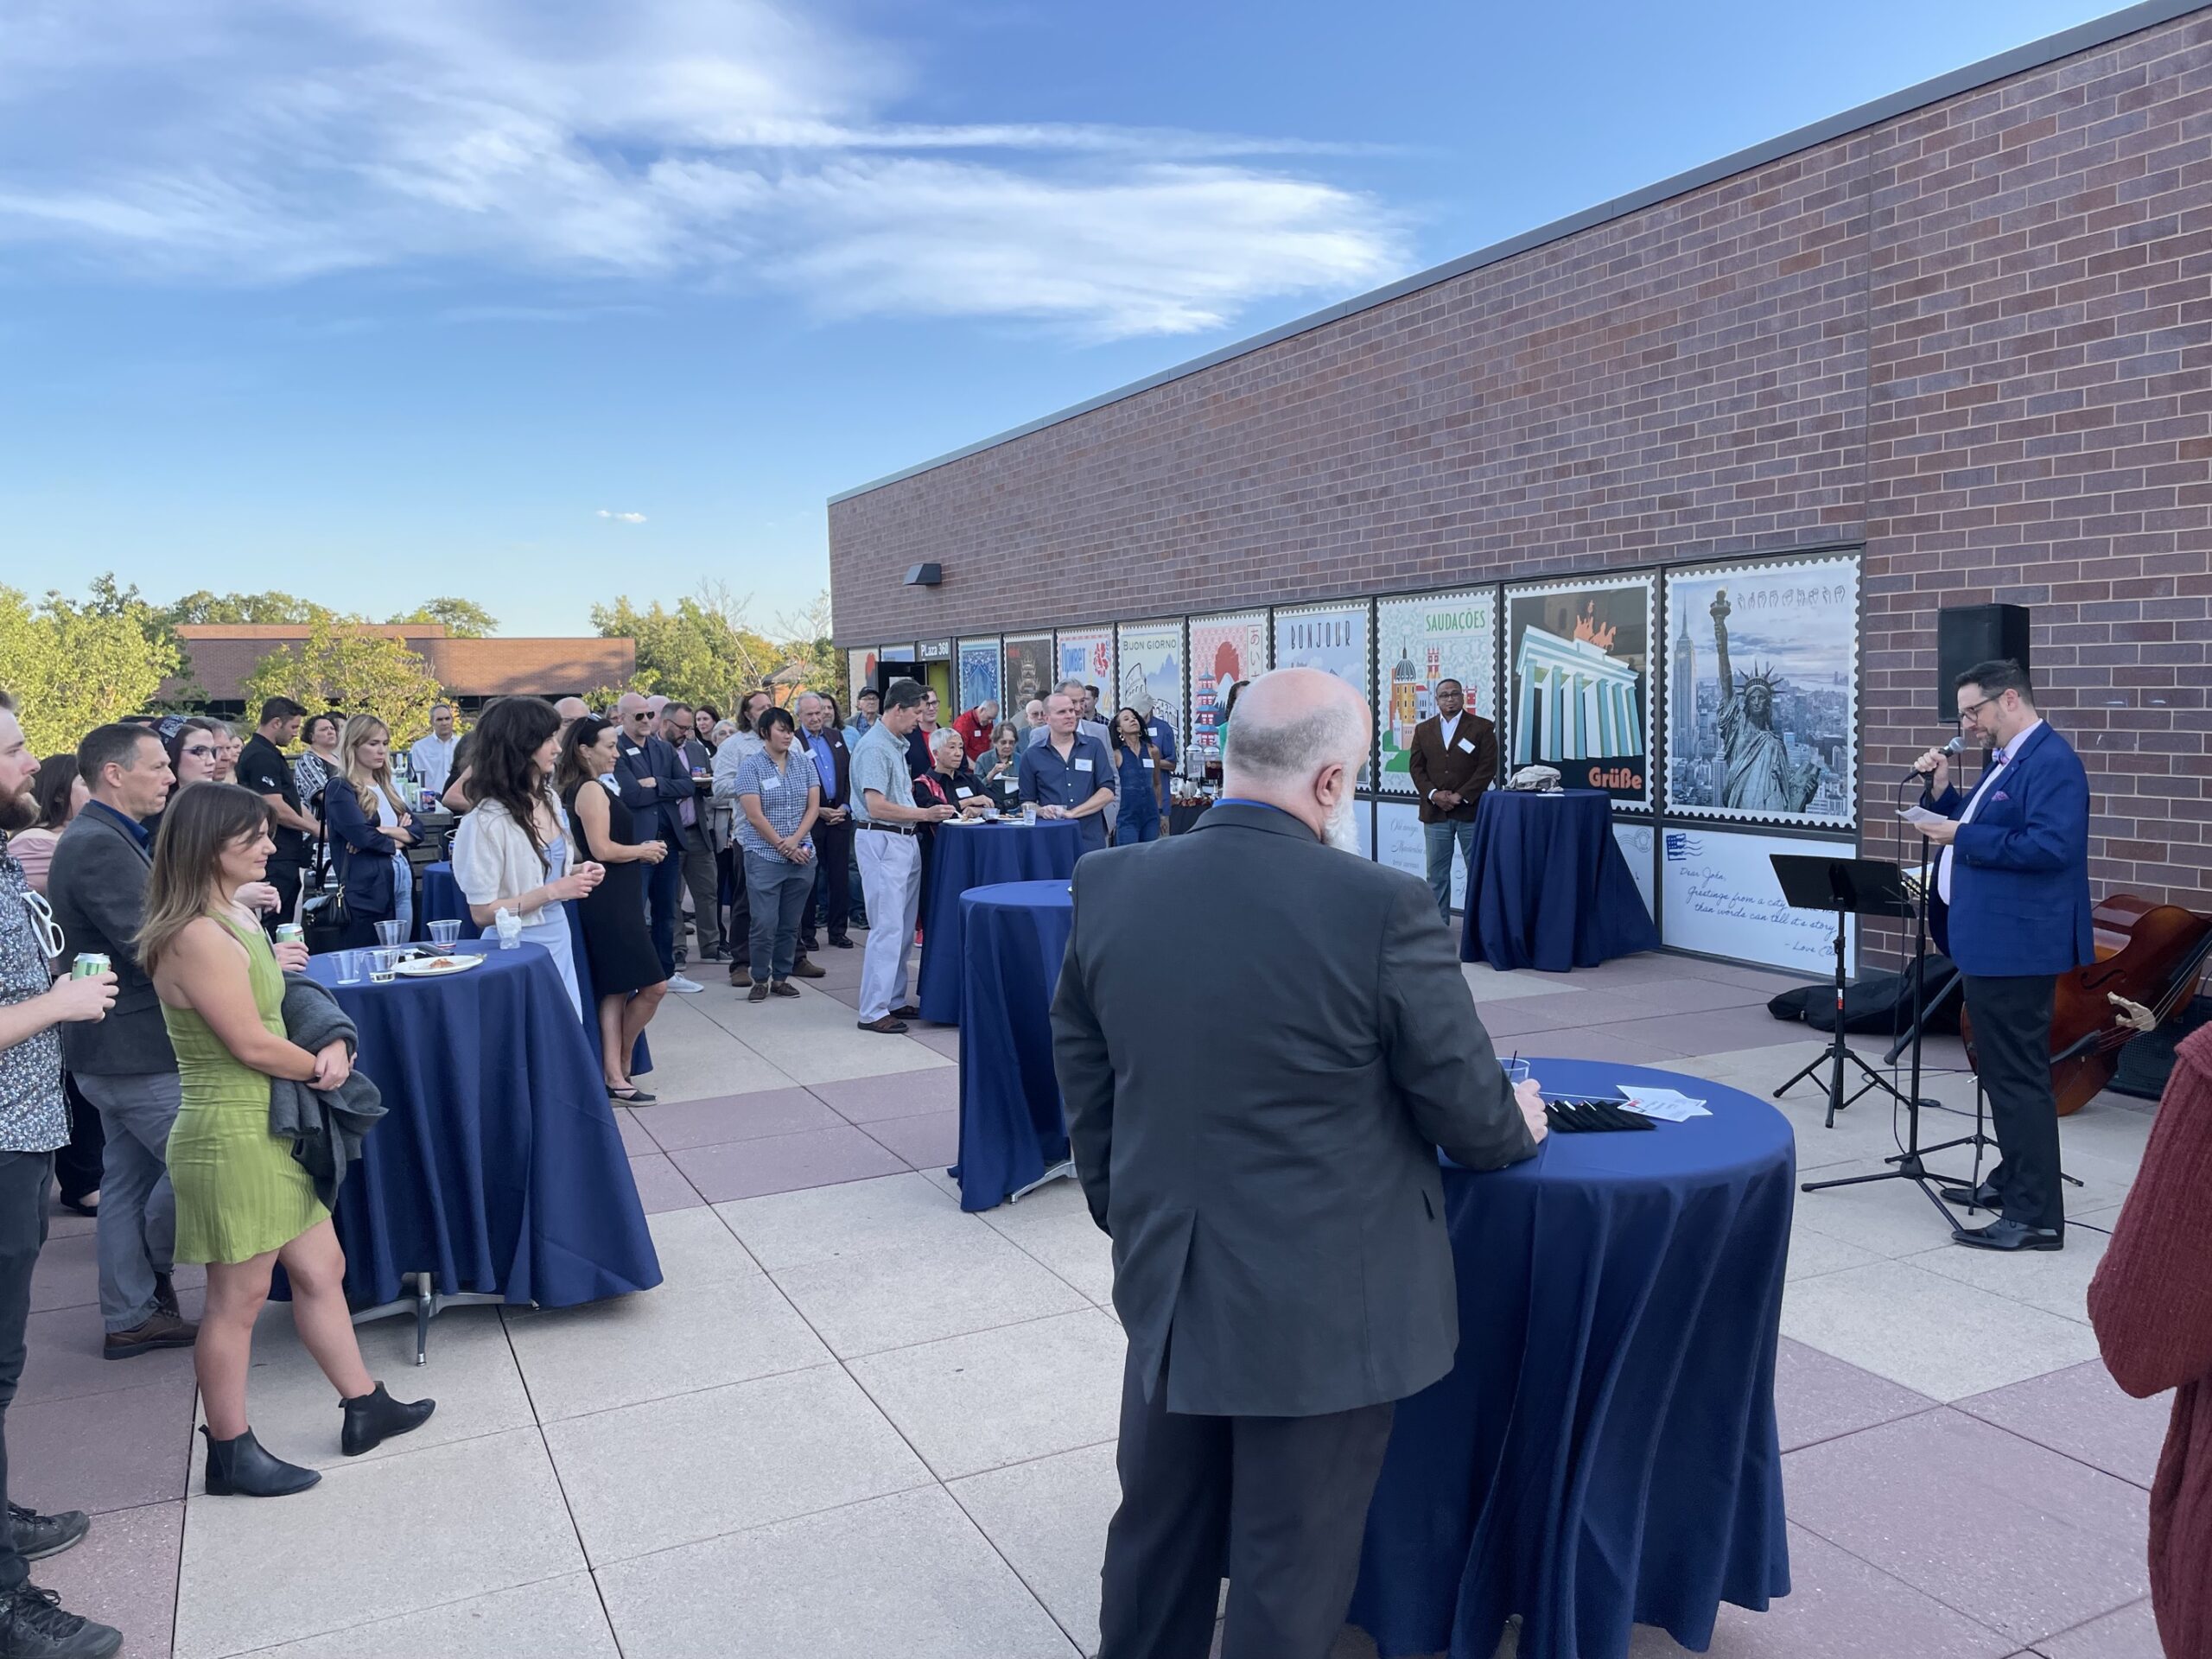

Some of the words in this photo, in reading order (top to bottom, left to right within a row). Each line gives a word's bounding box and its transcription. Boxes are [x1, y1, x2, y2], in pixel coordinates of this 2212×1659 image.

[1426, 607, 1485, 633] SAUDAÇÕES
[1123, 641, 1145, 651] BUON
[1147, 639, 1177, 650] GIORNO
[1291, 620, 1351, 650] BONJOUR
[938, 641, 949, 656] 360
[1061, 643, 1085, 677] Привет
[1588, 766, 1643, 790] Grüße
[1680, 868, 1700, 877] Dear
[1687, 886, 1729, 906] Greetings
[1728, 893, 1755, 909] from
[1767, 898, 1788, 915] city
[1694, 902, 1715, 913] than
[1717, 907, 1746, 918] words
[1770, 913, 1790, 925] tell
[1792, 941, 1816, 953] Love
